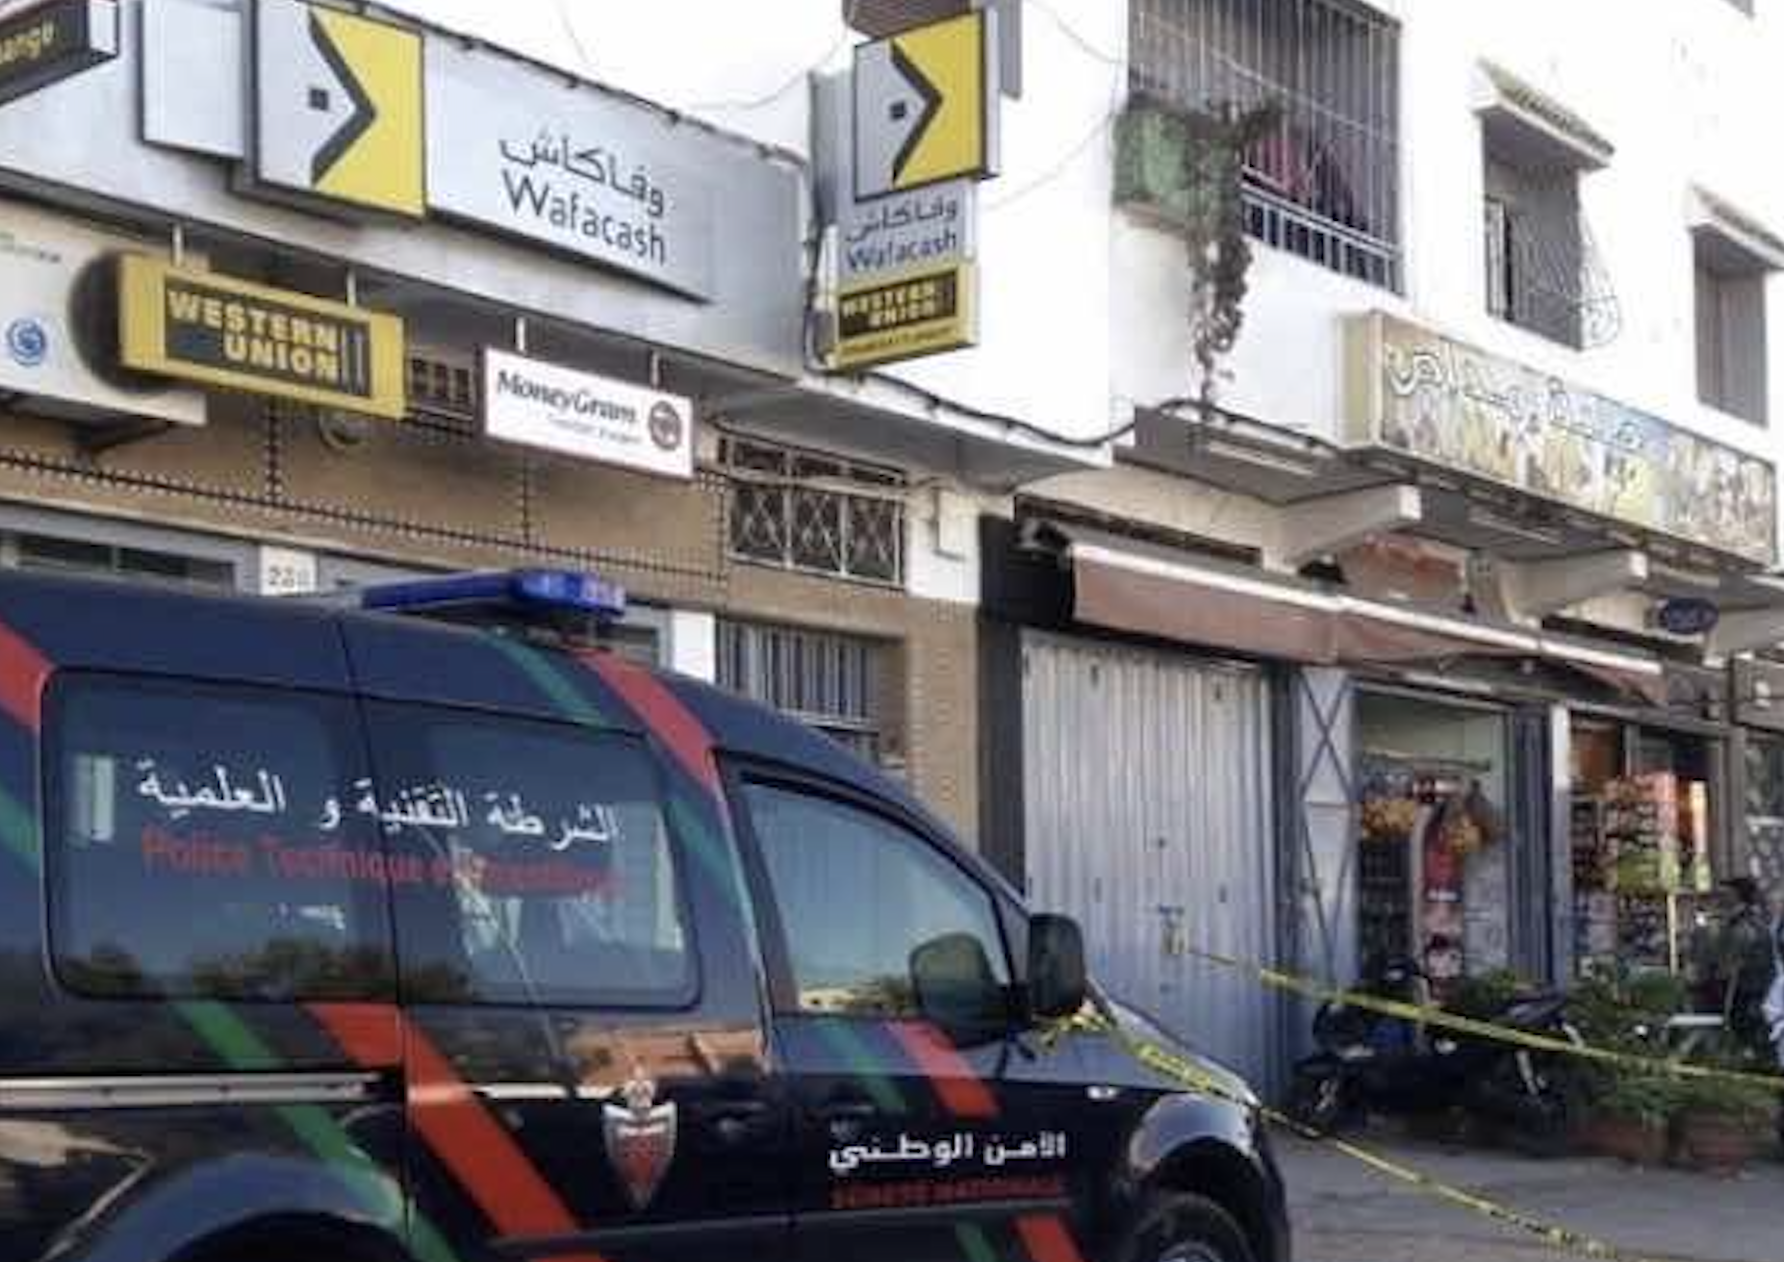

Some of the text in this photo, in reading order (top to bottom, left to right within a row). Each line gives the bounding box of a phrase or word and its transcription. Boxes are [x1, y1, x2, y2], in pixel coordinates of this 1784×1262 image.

[499, 128, 664, 218] وفاكاش
[502, 169, 666, 267] Wafacash
[846, 196, 958, 242] وفاكاش
[167, 290, 338, 350] WESTERN
[223, 333, 338, 381] UNION
[497, 370, 637, 423] MoneyGram
[136, 757, 622, 851] الشرطة التقنية و العلمية
[141, 826, 246, 873] Police
